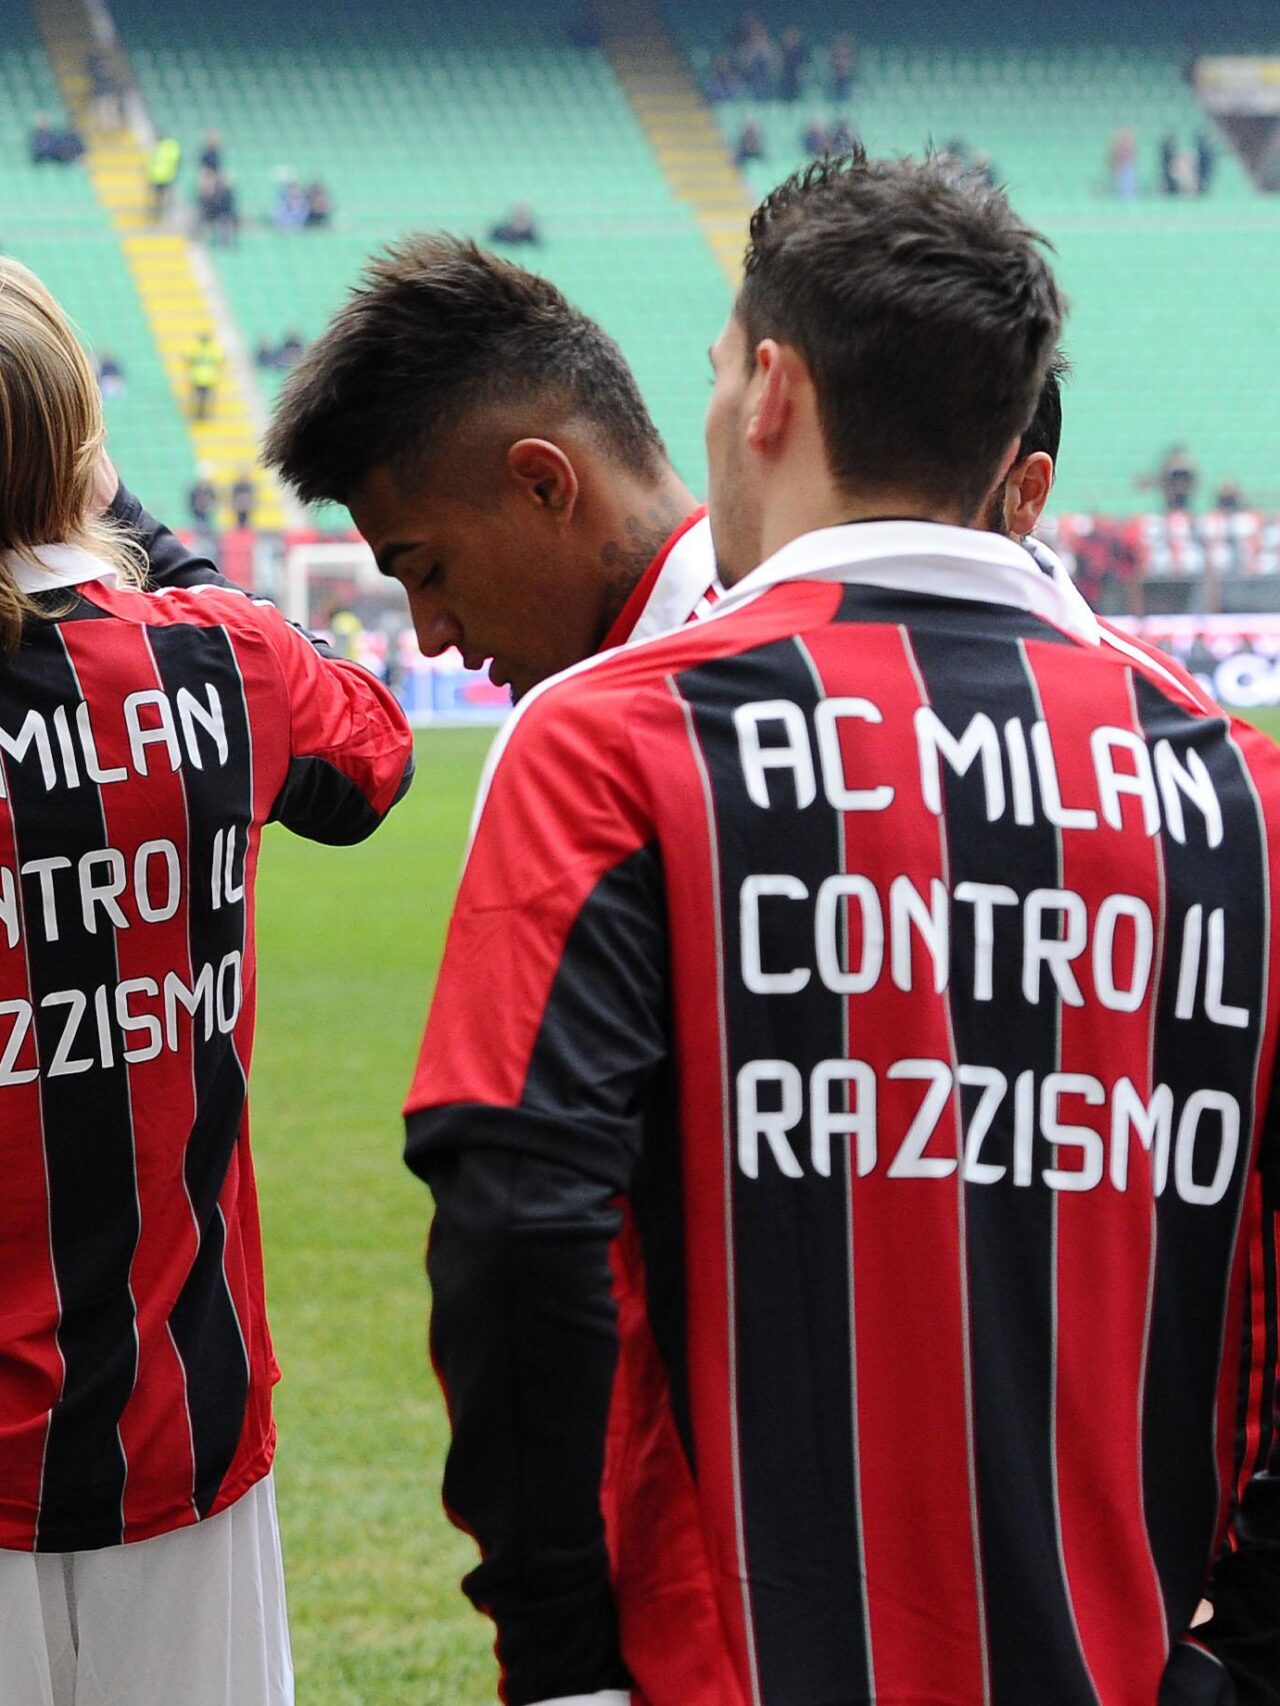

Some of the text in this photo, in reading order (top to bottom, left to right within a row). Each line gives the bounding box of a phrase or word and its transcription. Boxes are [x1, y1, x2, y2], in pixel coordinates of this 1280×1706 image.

[733, 697, 1222, 849] AC MILAN
[211, 825, 246, 910] IL
[740, 874, 1249, 1028] CONTRO IL
[736, 1059, 1240, 1205] RAZZISMO
